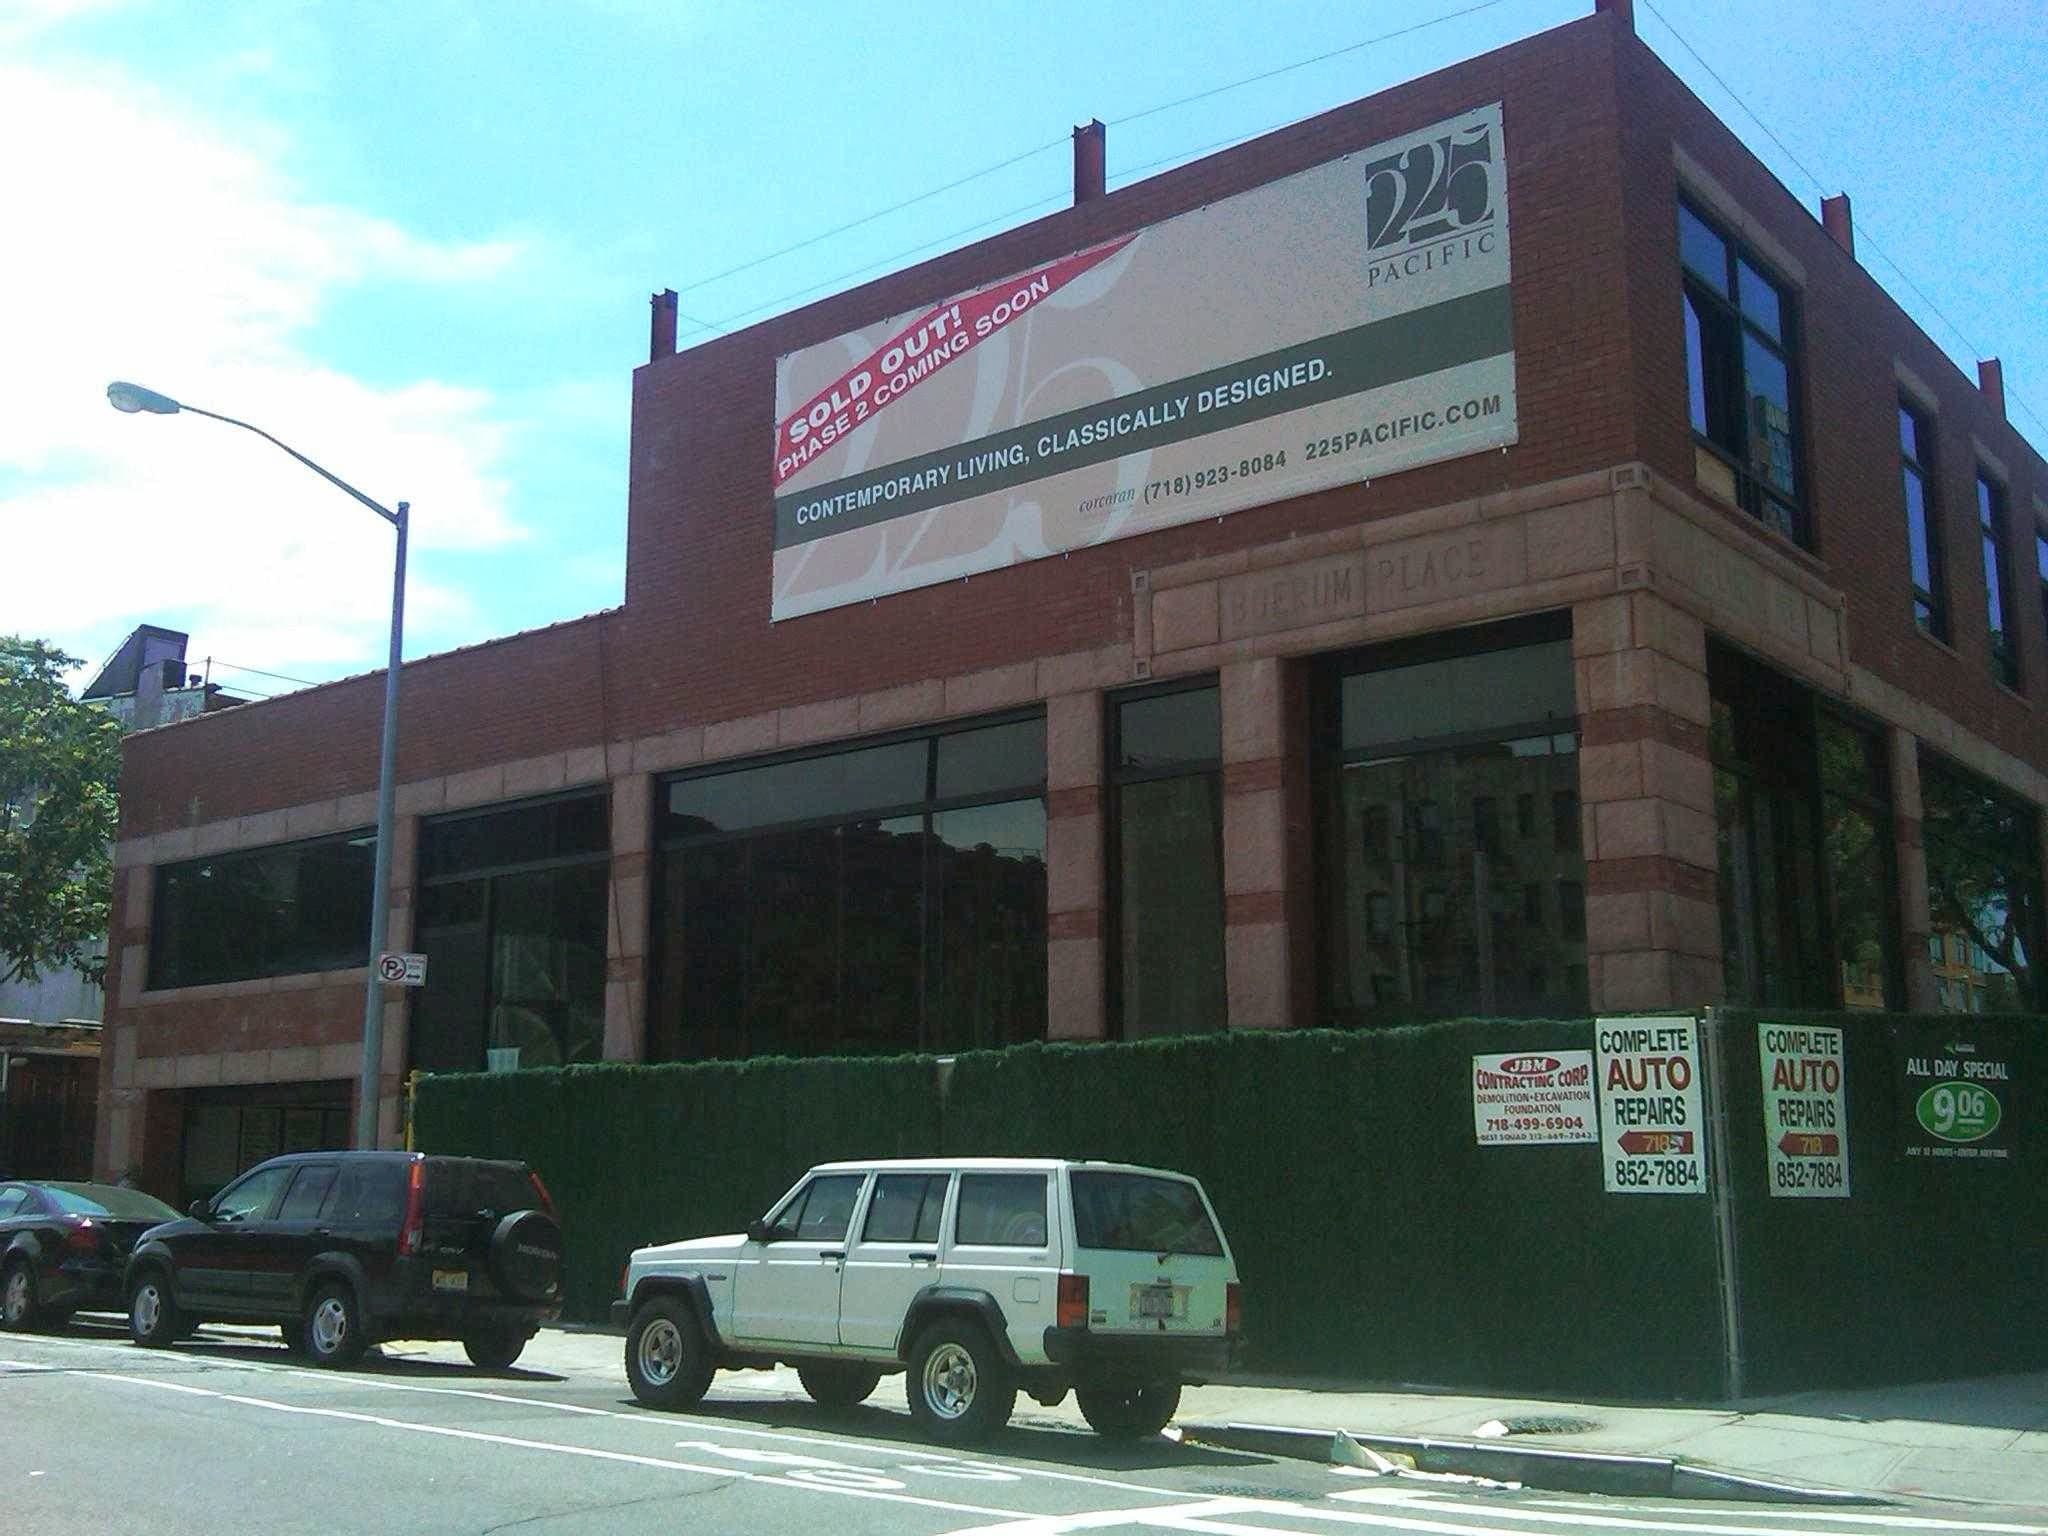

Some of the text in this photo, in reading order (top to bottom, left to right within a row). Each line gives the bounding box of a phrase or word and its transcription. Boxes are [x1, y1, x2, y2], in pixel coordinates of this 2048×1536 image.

[1367, 232, 1496, 288] PACIFIC
[778, 274, 1049, 479] PHASE 2 COMING SOON
[789, 303, 963, 445] SOLD OUT!
[796, 357, 1334, 526] CONTEMPORARY LIVING, CLASSICALLY DESIGNED.
[1078, 486, 1136, 513] corcoran
[1304, 393, 1502, 462] 225PACIFIC.COM
[1376, 538, 1486, 602] PLACE
[1599, 1028, 1689, 1054] COMPLETE
[1766, 1030, 1838, 1054] COMPLETE
[1476, 1068, 1555, 1091] CONTRACTING
[1509, 1057, 1548, 1073] JBM
[1607, 1056, 1692, 1092] AUTO
[1772, 1058, 1840, 1094] AUTO
[1906, 1058, 2009, 1081] ALL DAY SPECIAL
[1486, 1116, 1584, 1131] 718-499-6904
[1503, 1103, 1562, 1115] FOUNDATION
[1615, 1096, 1686, 1126] REPAIRS
[1778, 1098, 1837, 1128] REPAIRS
[1800, 1136, 1824, 1155] 718
[1615, 1160, 1699, 1187] 852-7884
[1776, 1161, 1843, 1189] 852-7884
